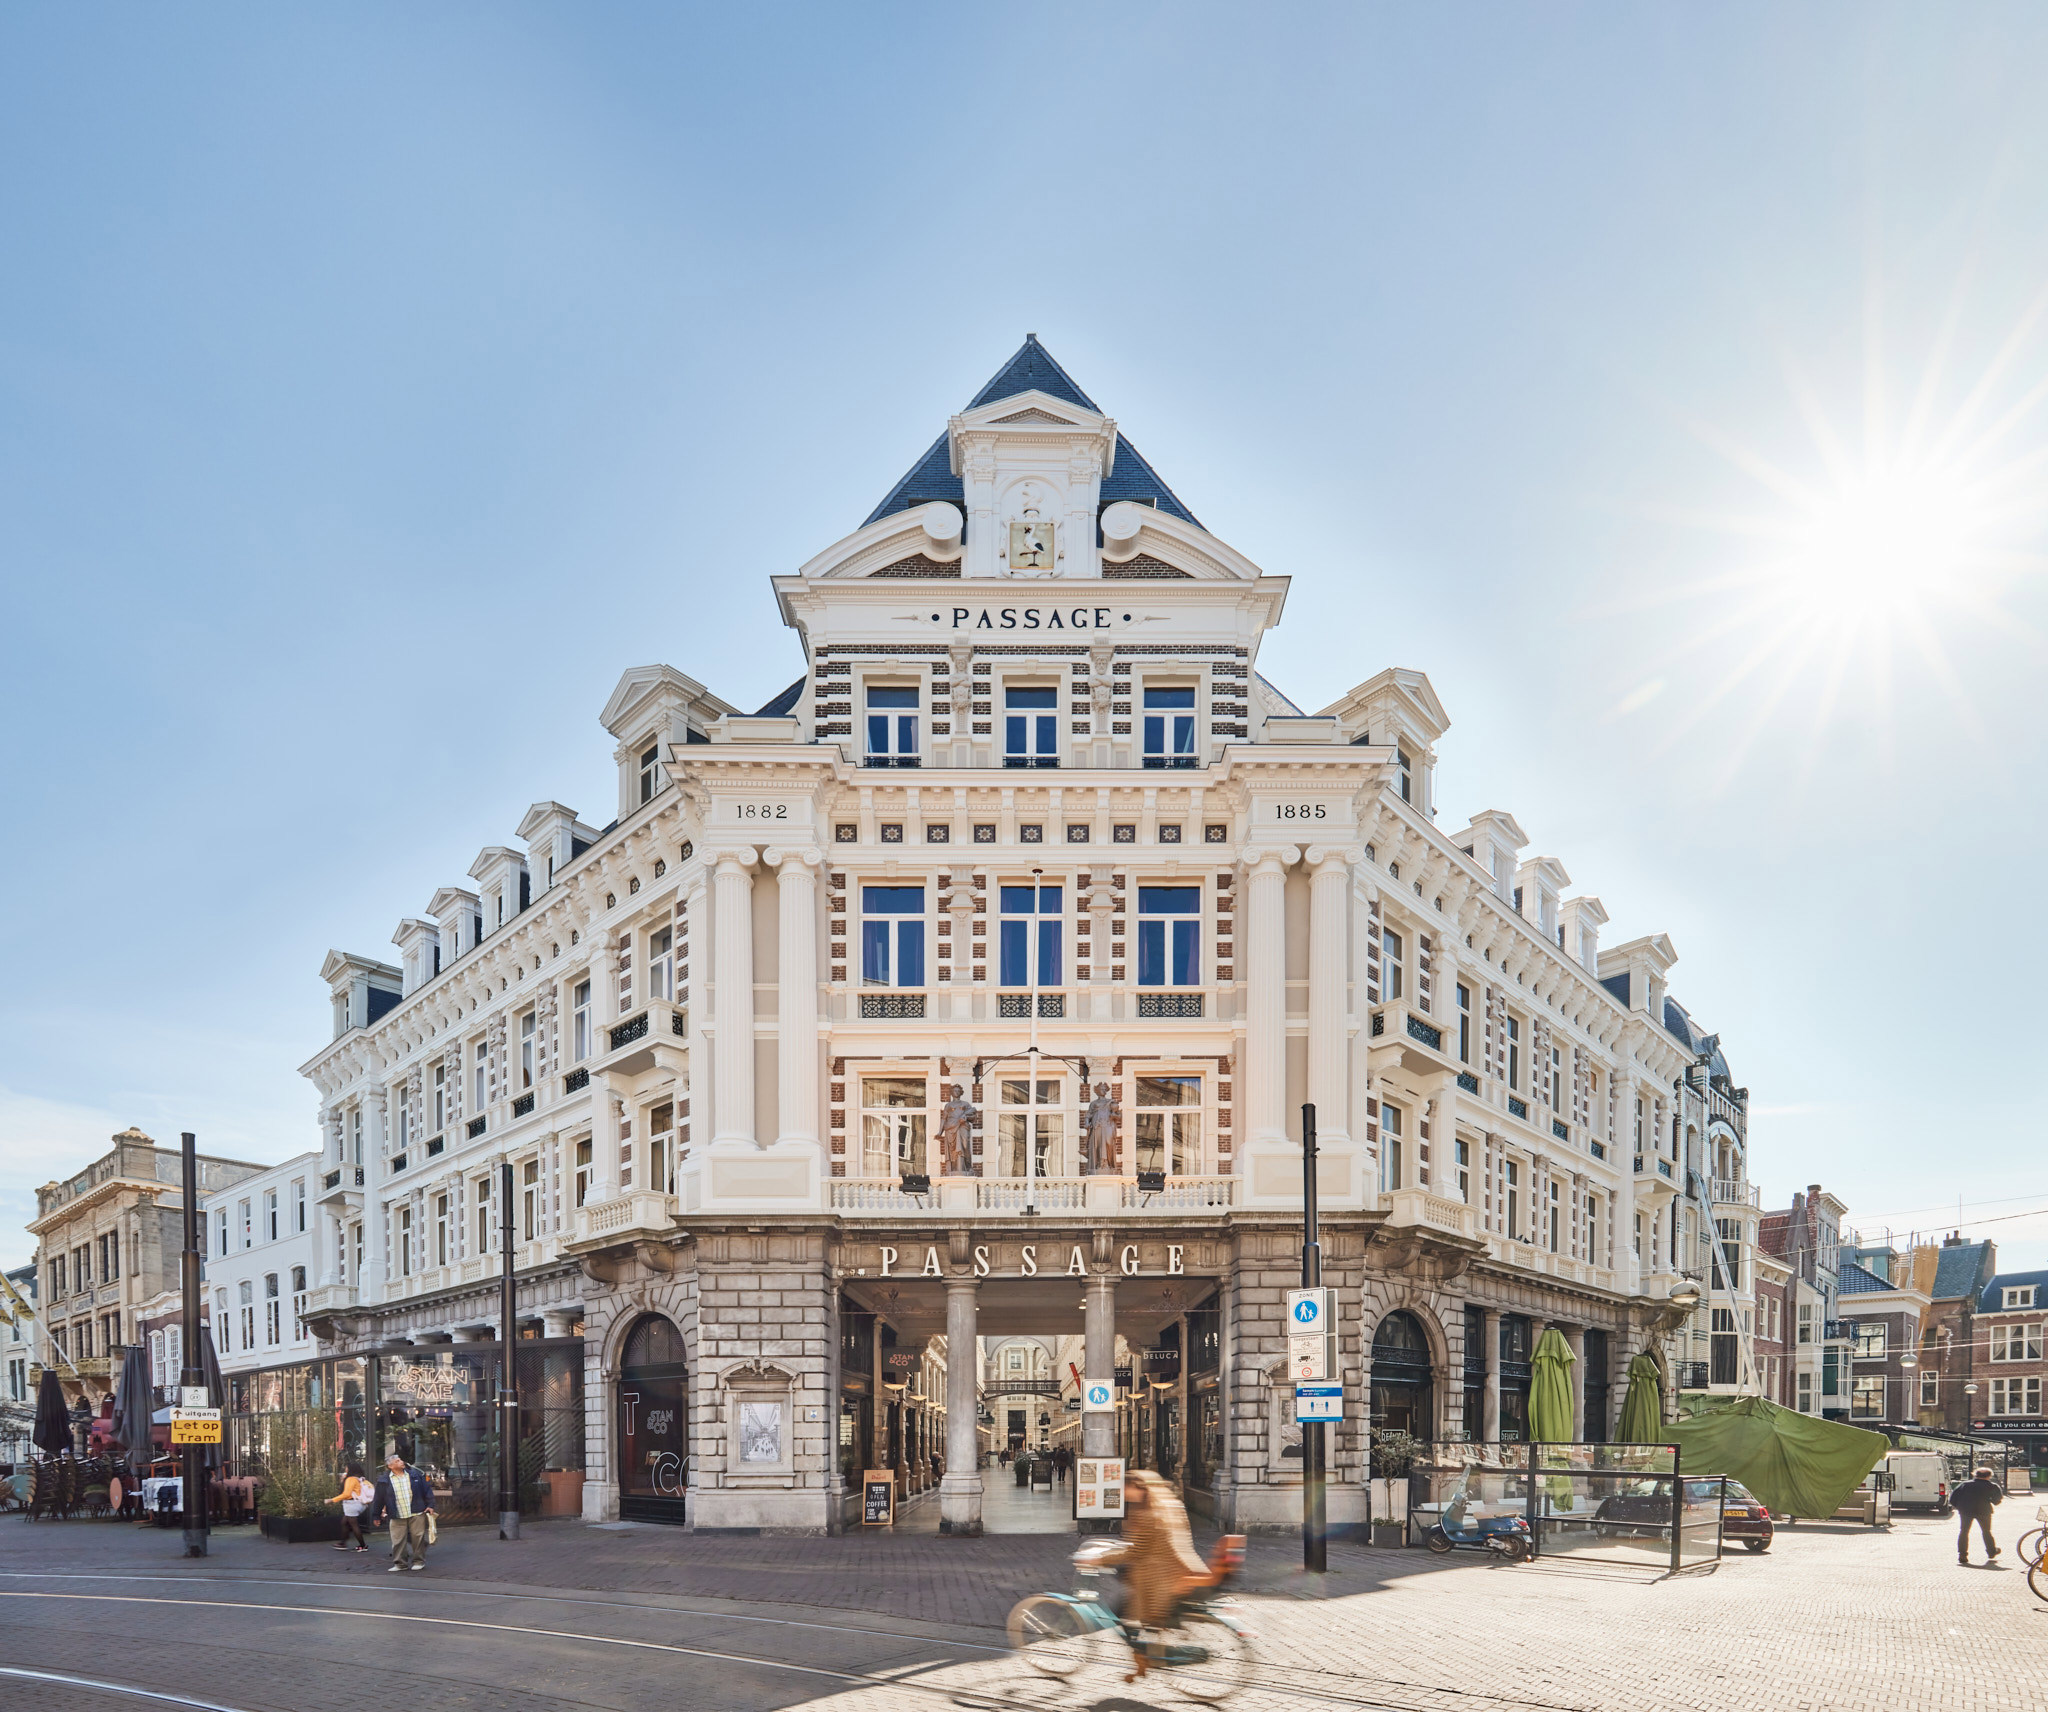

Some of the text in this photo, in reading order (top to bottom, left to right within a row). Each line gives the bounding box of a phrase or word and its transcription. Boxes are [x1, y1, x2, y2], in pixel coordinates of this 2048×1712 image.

[952, 608, 1111, 629] PASSAGE
[737, 804, 787, 818] 1882
[1276, 804, 1326, 818] 1885
[879, 1245, 1184, 1277] PASSAGE
[1143, 1352, 1179, 1360] DELUCA
[408, 1366, 468, 1385] STAN
[416, 1383, 454, 1400] ME
[650, 1410, 674, 1422] STAN
[173, 1421, 219, 1431] Let op
[653, 1421, 668, 1435] CO
[178, 1433, 216, 1442] Tram
